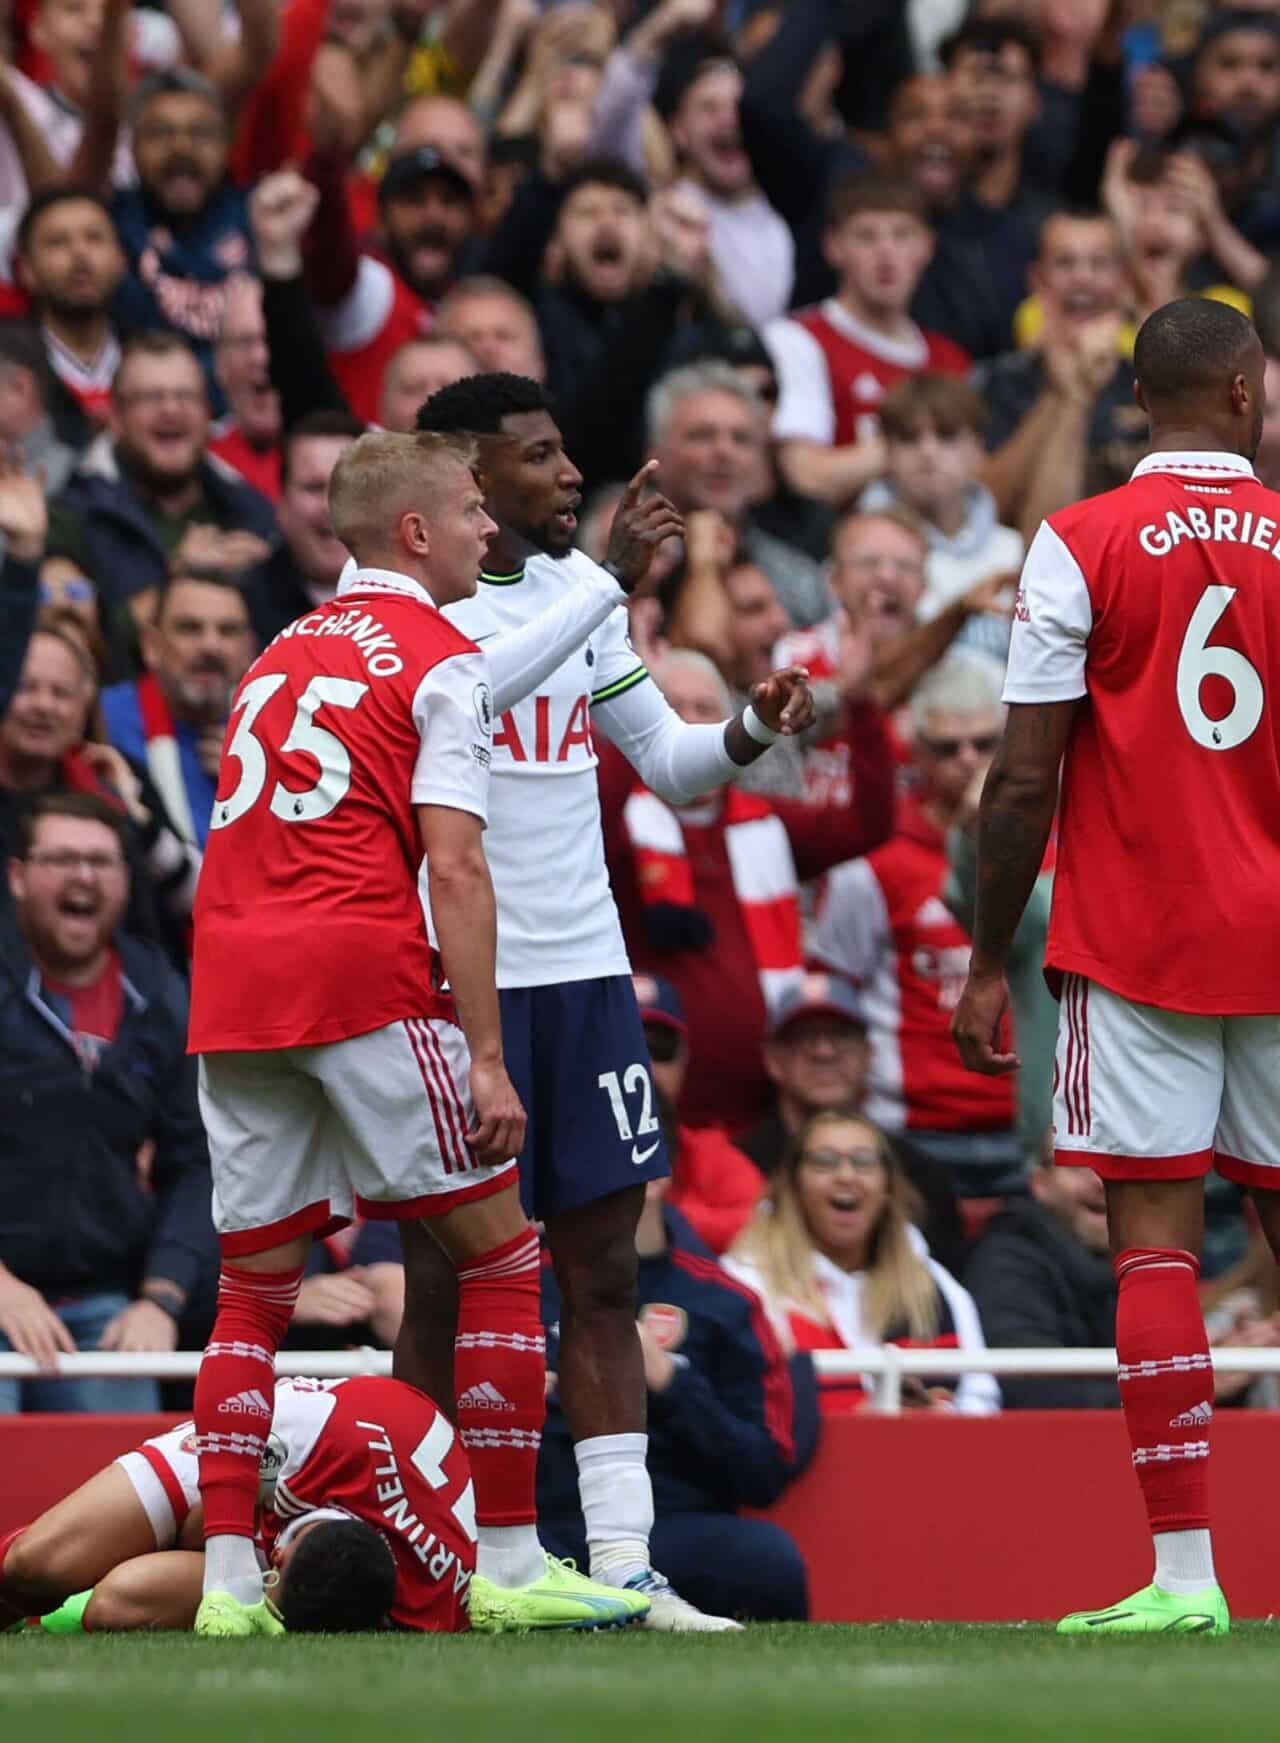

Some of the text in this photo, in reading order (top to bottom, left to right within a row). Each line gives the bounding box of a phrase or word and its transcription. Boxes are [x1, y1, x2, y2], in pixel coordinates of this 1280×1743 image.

[247, 608, 403, 677] NCHENKO
[1176, 584, 1265, 751] 6
[208, 673, 370, 831] 35
[598, 1063, 659, 1141] 12
